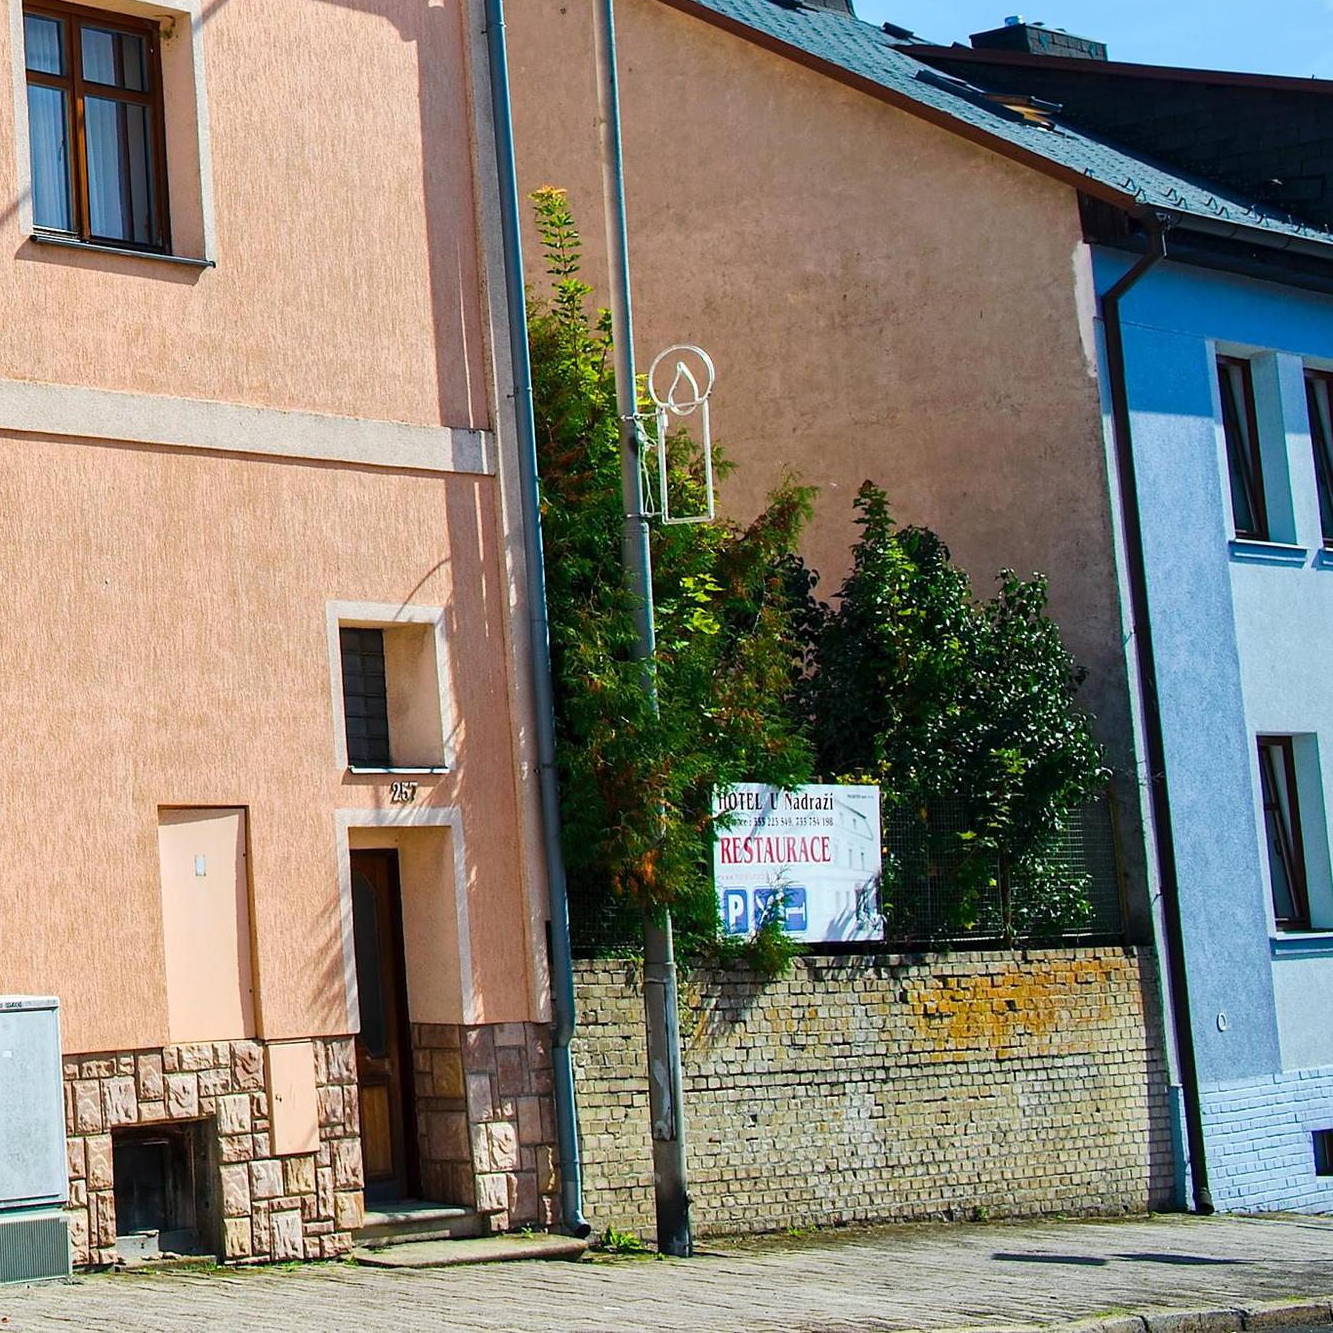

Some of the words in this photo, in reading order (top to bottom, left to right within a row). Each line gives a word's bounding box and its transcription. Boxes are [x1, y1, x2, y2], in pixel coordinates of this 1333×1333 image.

[390, 780, 418, 804] 257
[718, 792, 762, 810] HOTEL
[770, 792, 779, 810] U
[720, 836, 832, 864] RESTAURACE
[728, 893, 744, 932] P
